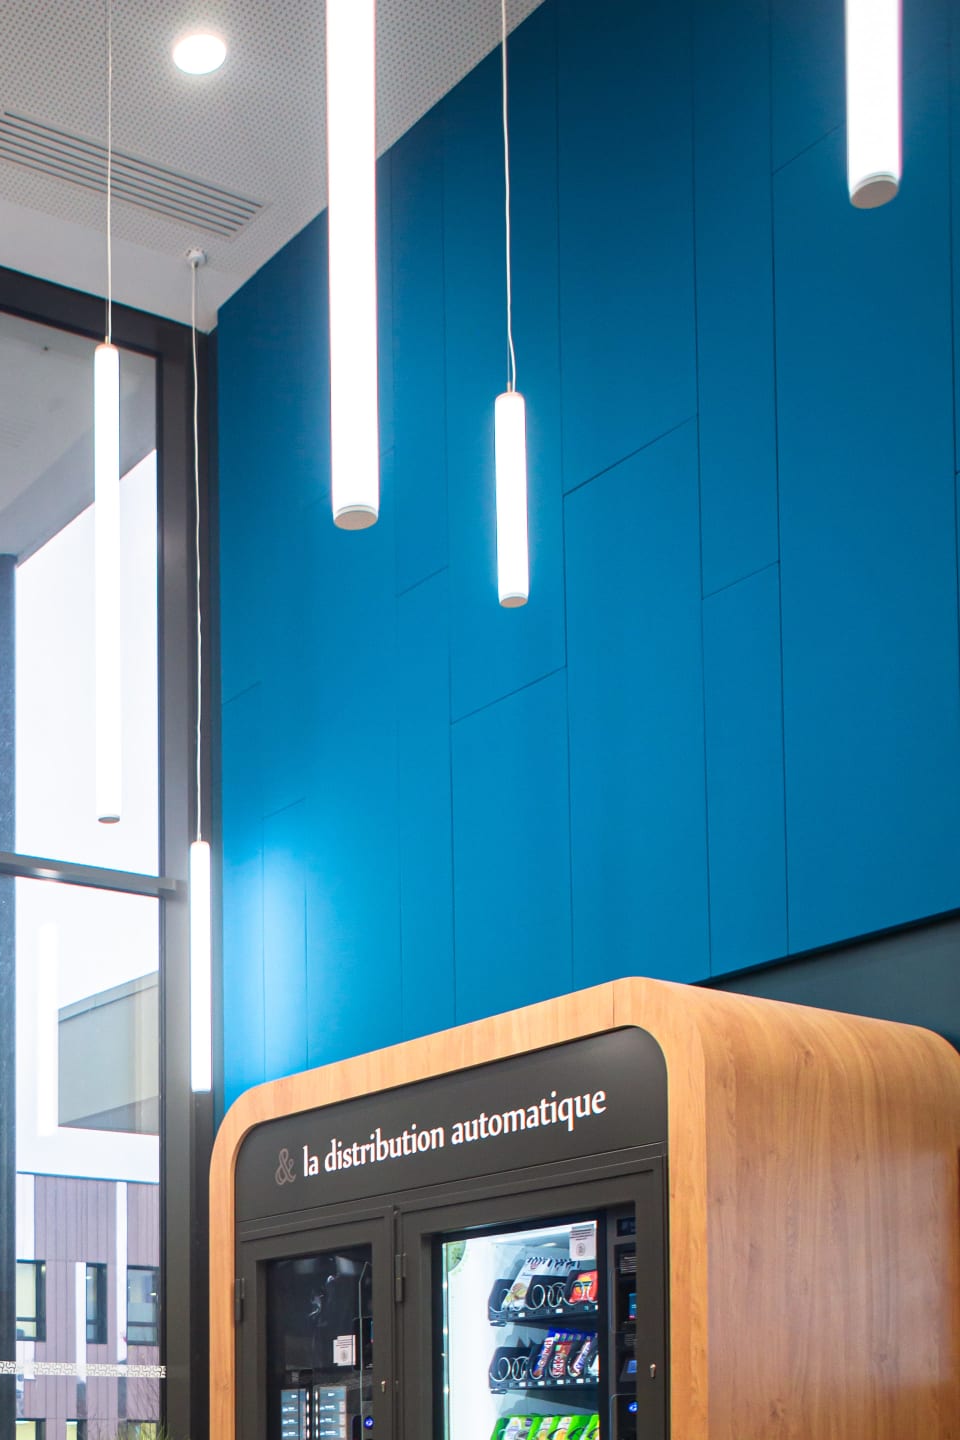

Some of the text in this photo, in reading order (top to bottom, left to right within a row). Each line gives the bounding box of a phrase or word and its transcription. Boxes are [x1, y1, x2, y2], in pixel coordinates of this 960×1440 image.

[274, 1089, 608, 1186] & la distribution automatique
